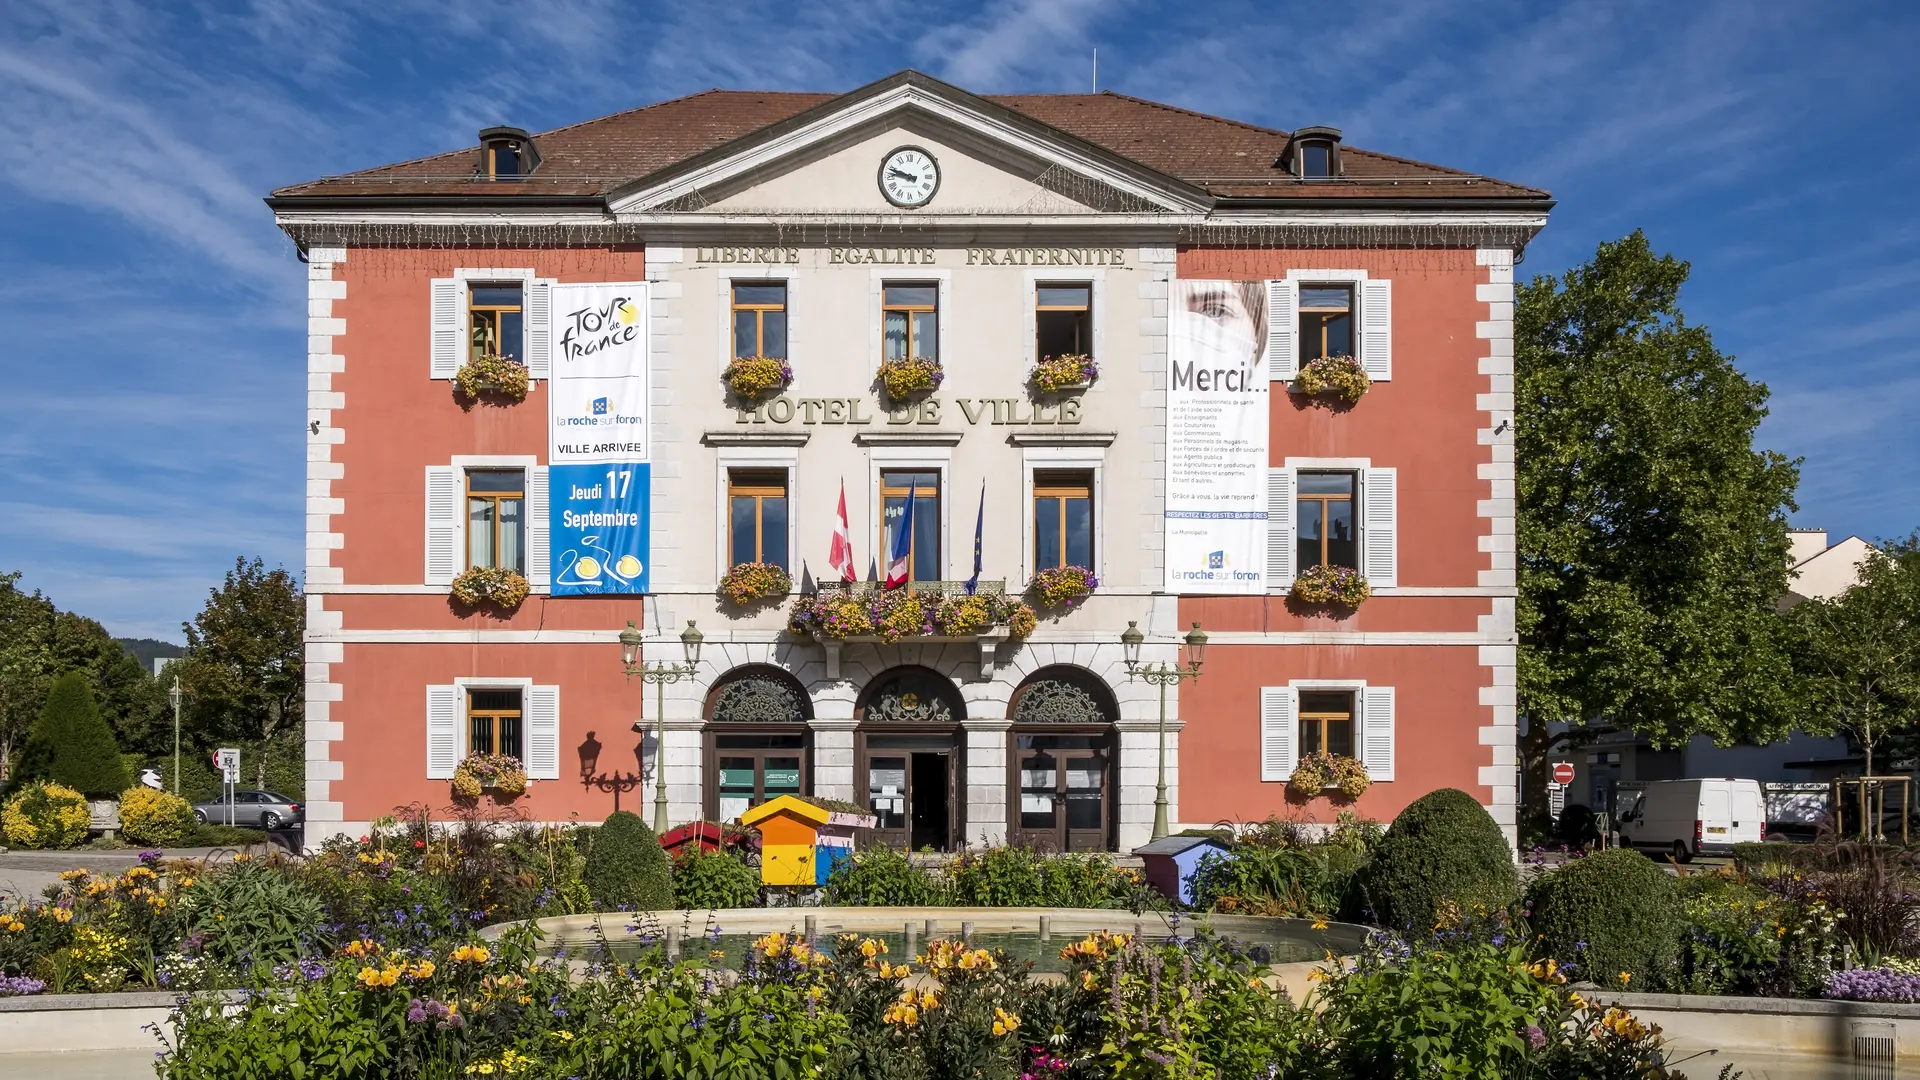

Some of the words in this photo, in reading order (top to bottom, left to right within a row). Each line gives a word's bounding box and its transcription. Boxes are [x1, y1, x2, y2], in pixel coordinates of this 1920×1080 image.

[695, 247, 800, 264] LIBERTE
[829, 247, 936, 264] EGALITE
[965, 247, 1126, 265] FRATERNITE
[609, 322, 620, 331] de
[1172, 360, 1268, 392] Merci...
[557, 416, 566, 426] la
[568, 416, 598, 425] roche
[600, 418, 615, 426] sur
[616, 414, 642, 425] foron
[955, 398, 1083, 426] VILLE
[558, 444, 590, 454] VILLE
[592, 443, 641, 453] ARRIVEE
[569, 484, 602, 500] Jeudi
[606, 470, 632, 499] 17
[563, 509, 638, 532] Septembre
[1172, 569, 1181, 580] la
[1183, 570, 1214, 580] roche
[1215, 572, 1231, 580] sur
[1233, 570, 1260, 580] foron
